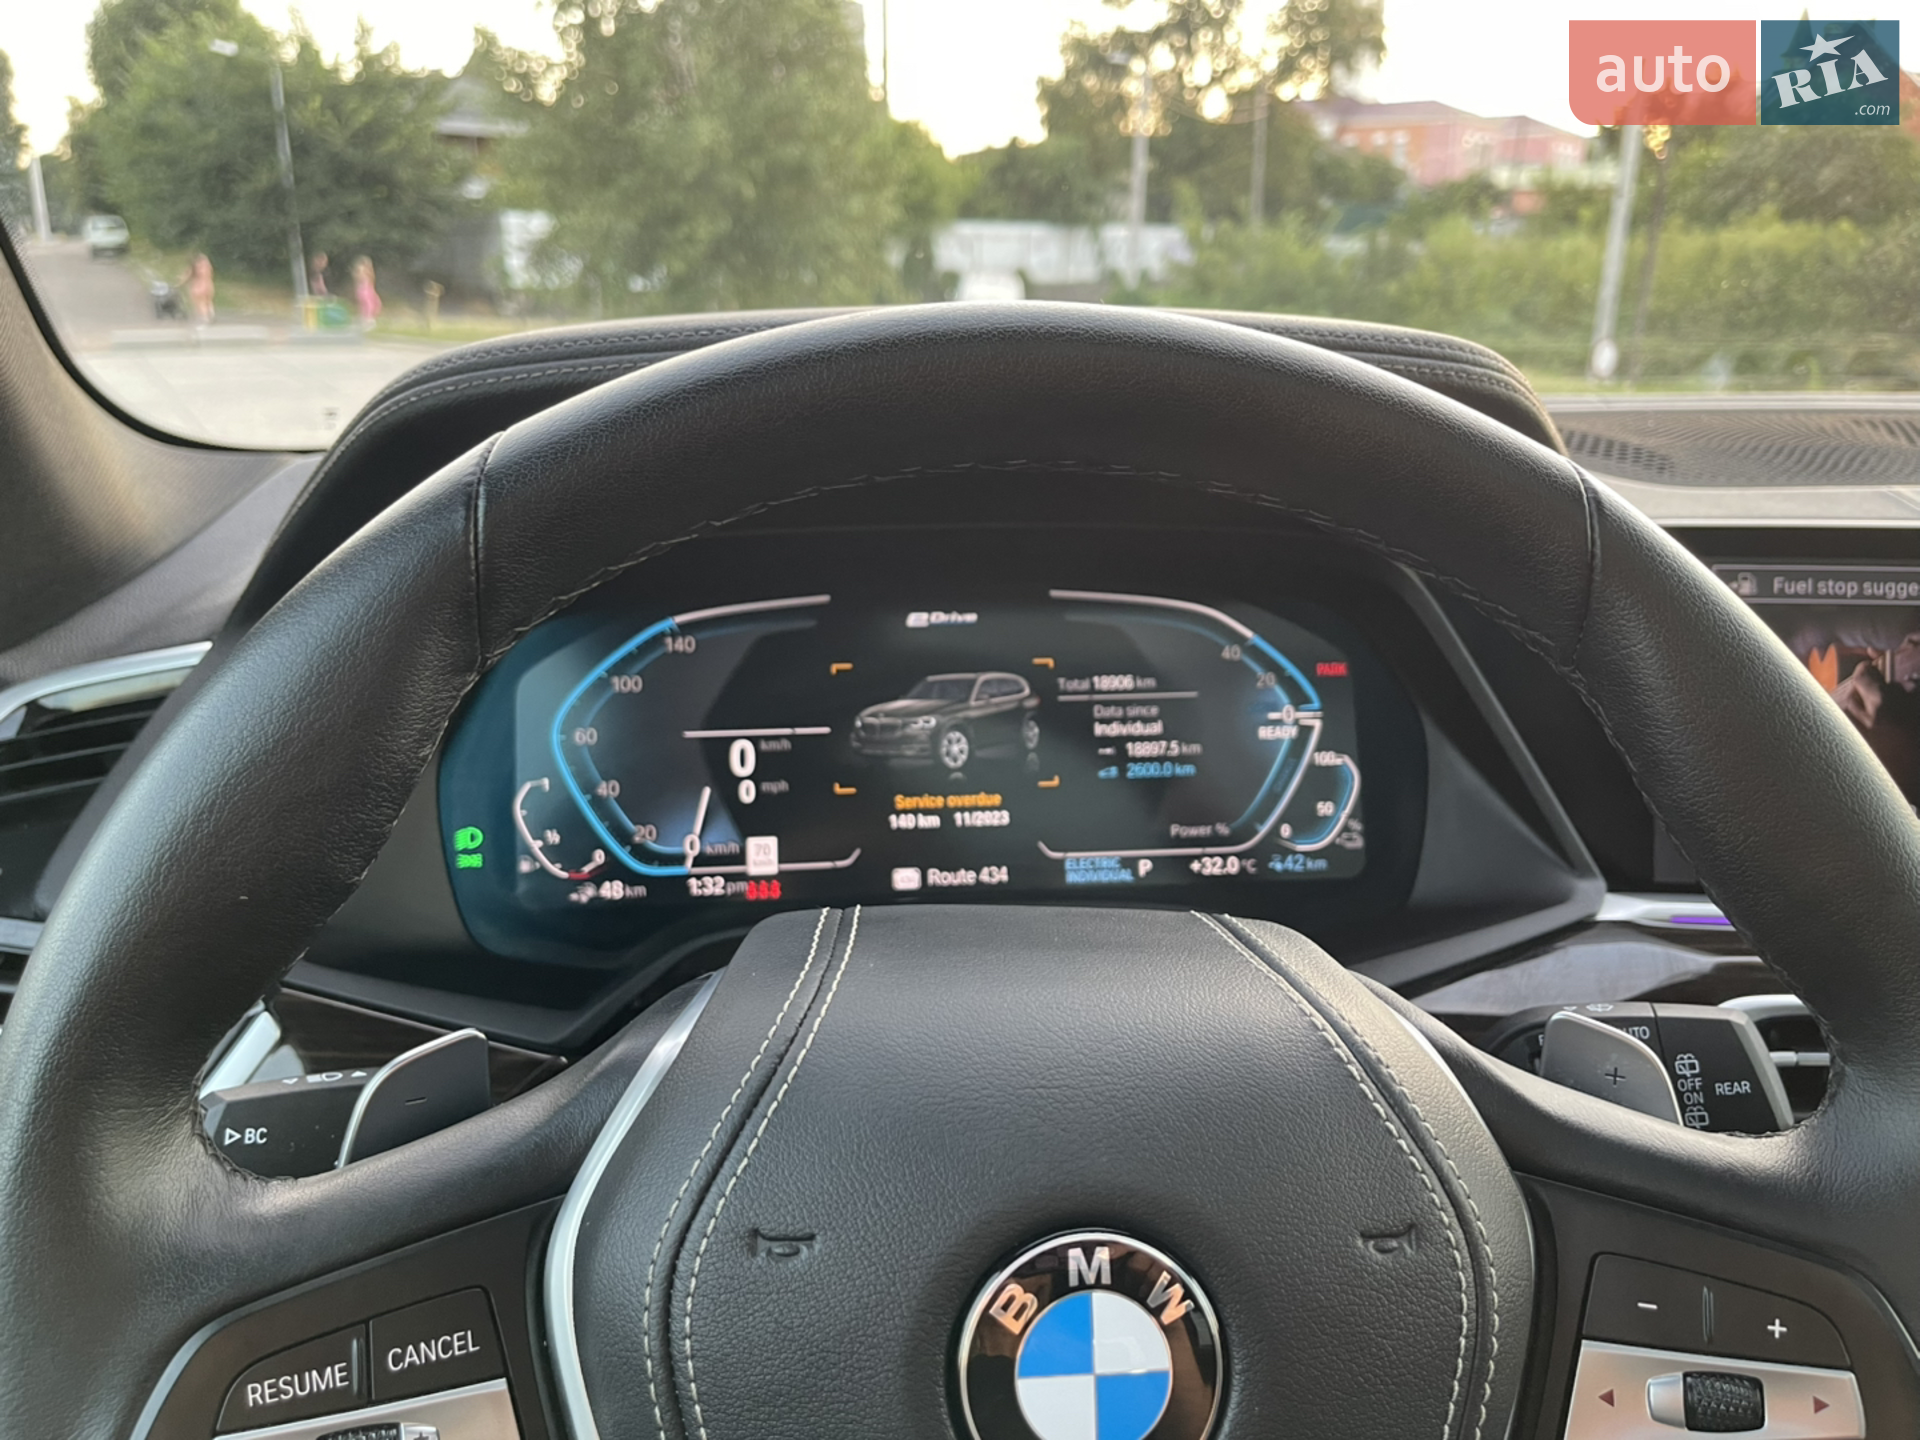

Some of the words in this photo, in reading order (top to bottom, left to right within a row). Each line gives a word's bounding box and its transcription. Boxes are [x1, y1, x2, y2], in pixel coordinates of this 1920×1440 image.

[1773, 577, 1813, 595] Fuel
[1816, 579, 1857, 598] stop
[1862, 580, 1920, 600] sugge
[664, 636, 696, 653] 140
[1221, 645, 1241, 661] 40
[611, 675, 643, 693] 100
[1057, 677, 1090, 691] Total
[1092, 674, 1134, 691] 18906
[1136, 676, 1157, 688] km
[1256, 672, 1276, 688] 20
[1093, 704, 1123, 719] Data
[1125, 703, 1160, 717] since
[574, 727, 598, 745] 60
[1093, 720, 1164, 737] Individual
[1258, 725, 1298, 740] READY
[1125, 740, 1180, 757] 18897.5
[1181, 742, 1203, 755] km
[729, 738, 756, 777] 0
[760, 738, 791, 751] km/h
[1126, 761, 1173, 779] 2600.0
[1174, 763, 1197, 777] km
[597, 780, 620, 797] 40
[738, 779, 756, 804] 0
[760, 780, 789, 794] mph
[894, 793, 945, 811] Service
[946, 791, 1002, 808] overdue
[1317, 801, 1334, 816] 50
[888, 813, 916, 830] 140
[917, 813, 941, 829] km
[1171, 823, 1212, 838] Power
[1215, 822, 1230, 836] %
[633, 825, 657, 843] 20
[1280, 823, 1292, 839] 0
[683, 834, 700, 857] 0
[705, 841, 740, 855] km/h
[754, 843, 772, 856] 70
[1064, 856, 1121, 870] ELECTRIC
[1138, 858, 1153, 878] P
[1190, 856, 1240, 876] +32.0
[1306, 857, 1329, 870] km
[927, 868, 977, 887] Route
[978, 865, 1009, 884] 434
[1065, 869, 1135, 885] INDIVIDUAL
[599, 879, 624, 900] 48
[624, 883, 647, 898] km
[687, 875, 725, 896] 1:32
[725, 880, 748, 896] pm
[1619, 1026, 1650, 1040] UTO
[1677, 1078, 1703, 1092] OFF
[1715, 1081, 1751, 1096] REAR
[1683, 1092, 1704, 1104] ON
[244, 1127, 268, 1144] BC
[989, 1246, 1195, 1336] BMW
[387, 1329, 481, 1372] CANCEL
[247, 1362, 349, 1408] RESUME
